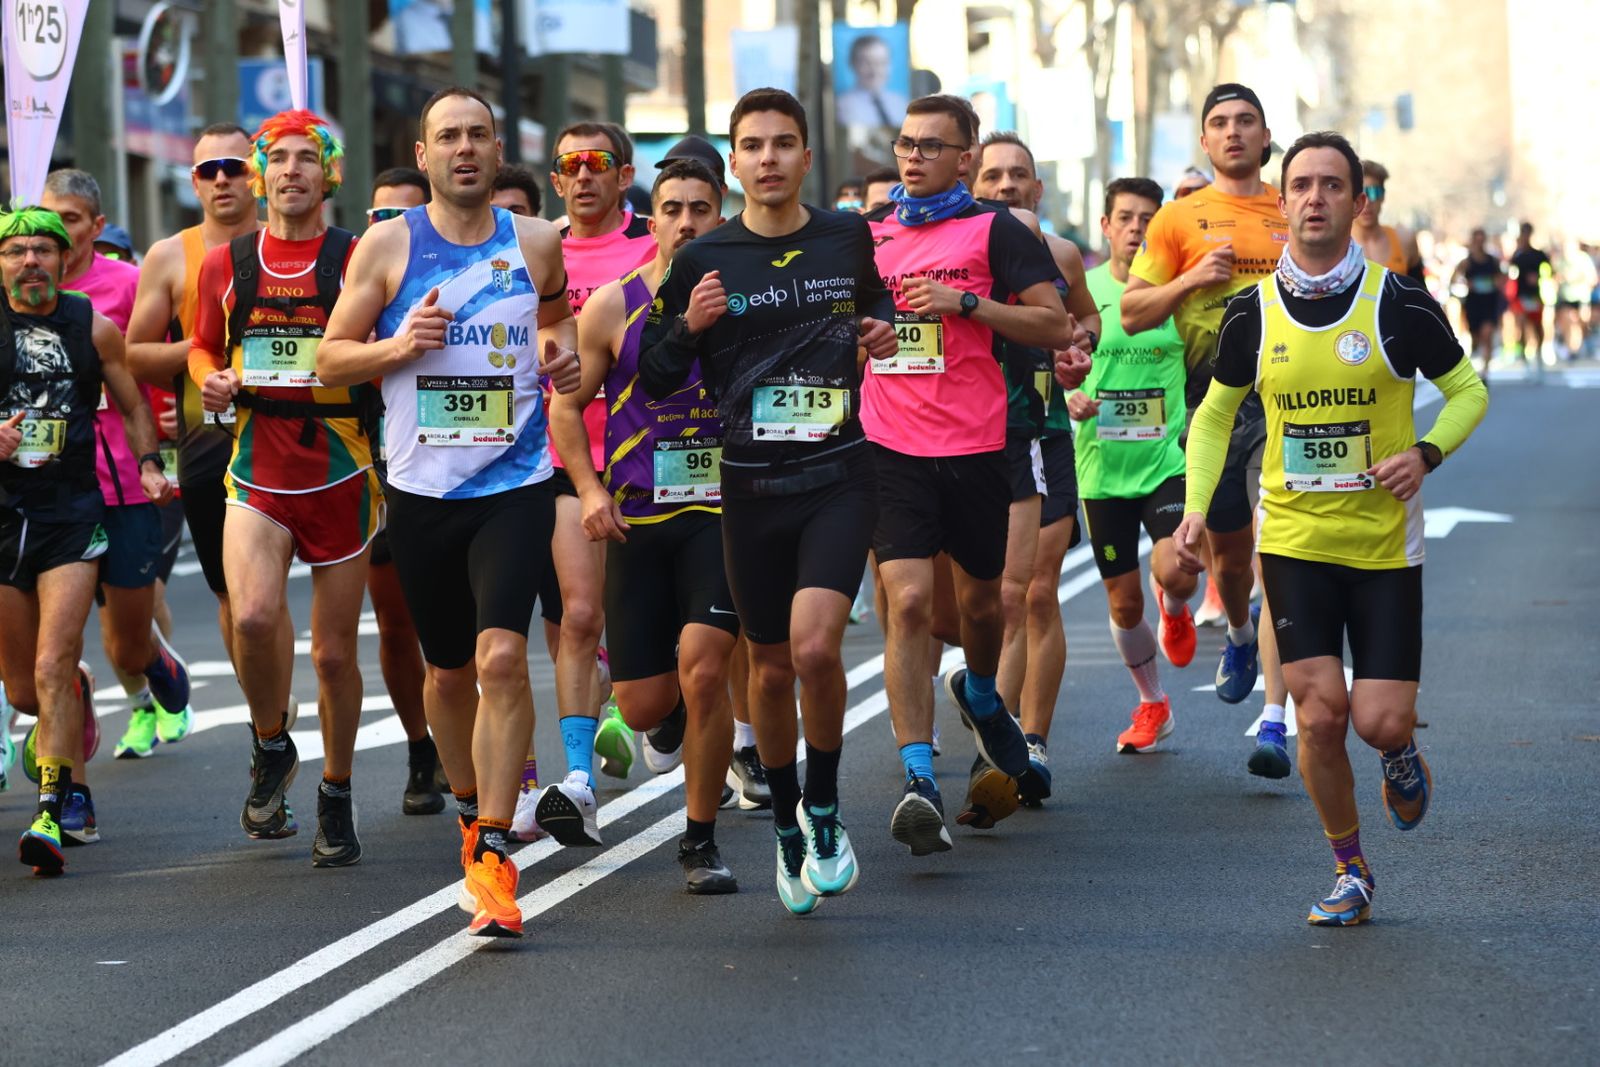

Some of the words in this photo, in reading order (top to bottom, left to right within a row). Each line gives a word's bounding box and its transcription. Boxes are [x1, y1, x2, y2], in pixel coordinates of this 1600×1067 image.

[266, 286, 304, 297] VINO
[804, 276, 855, 290] Maratona
[749, 285, 788, 308] edp
[807, 293, 822, 303] do
[824, 289, 851, 300] Porto
[271, 340, 299, 357] 90
[443, 393, 487, 412] 391
[772, 389, 832, 409] 2113
[1273, 387, 1377, 411] VILLORUELA
[1113, 402, 1149, 416] 293
[1303, 441, 1348, 460] 580
[686, 451, 713, 470] 96
